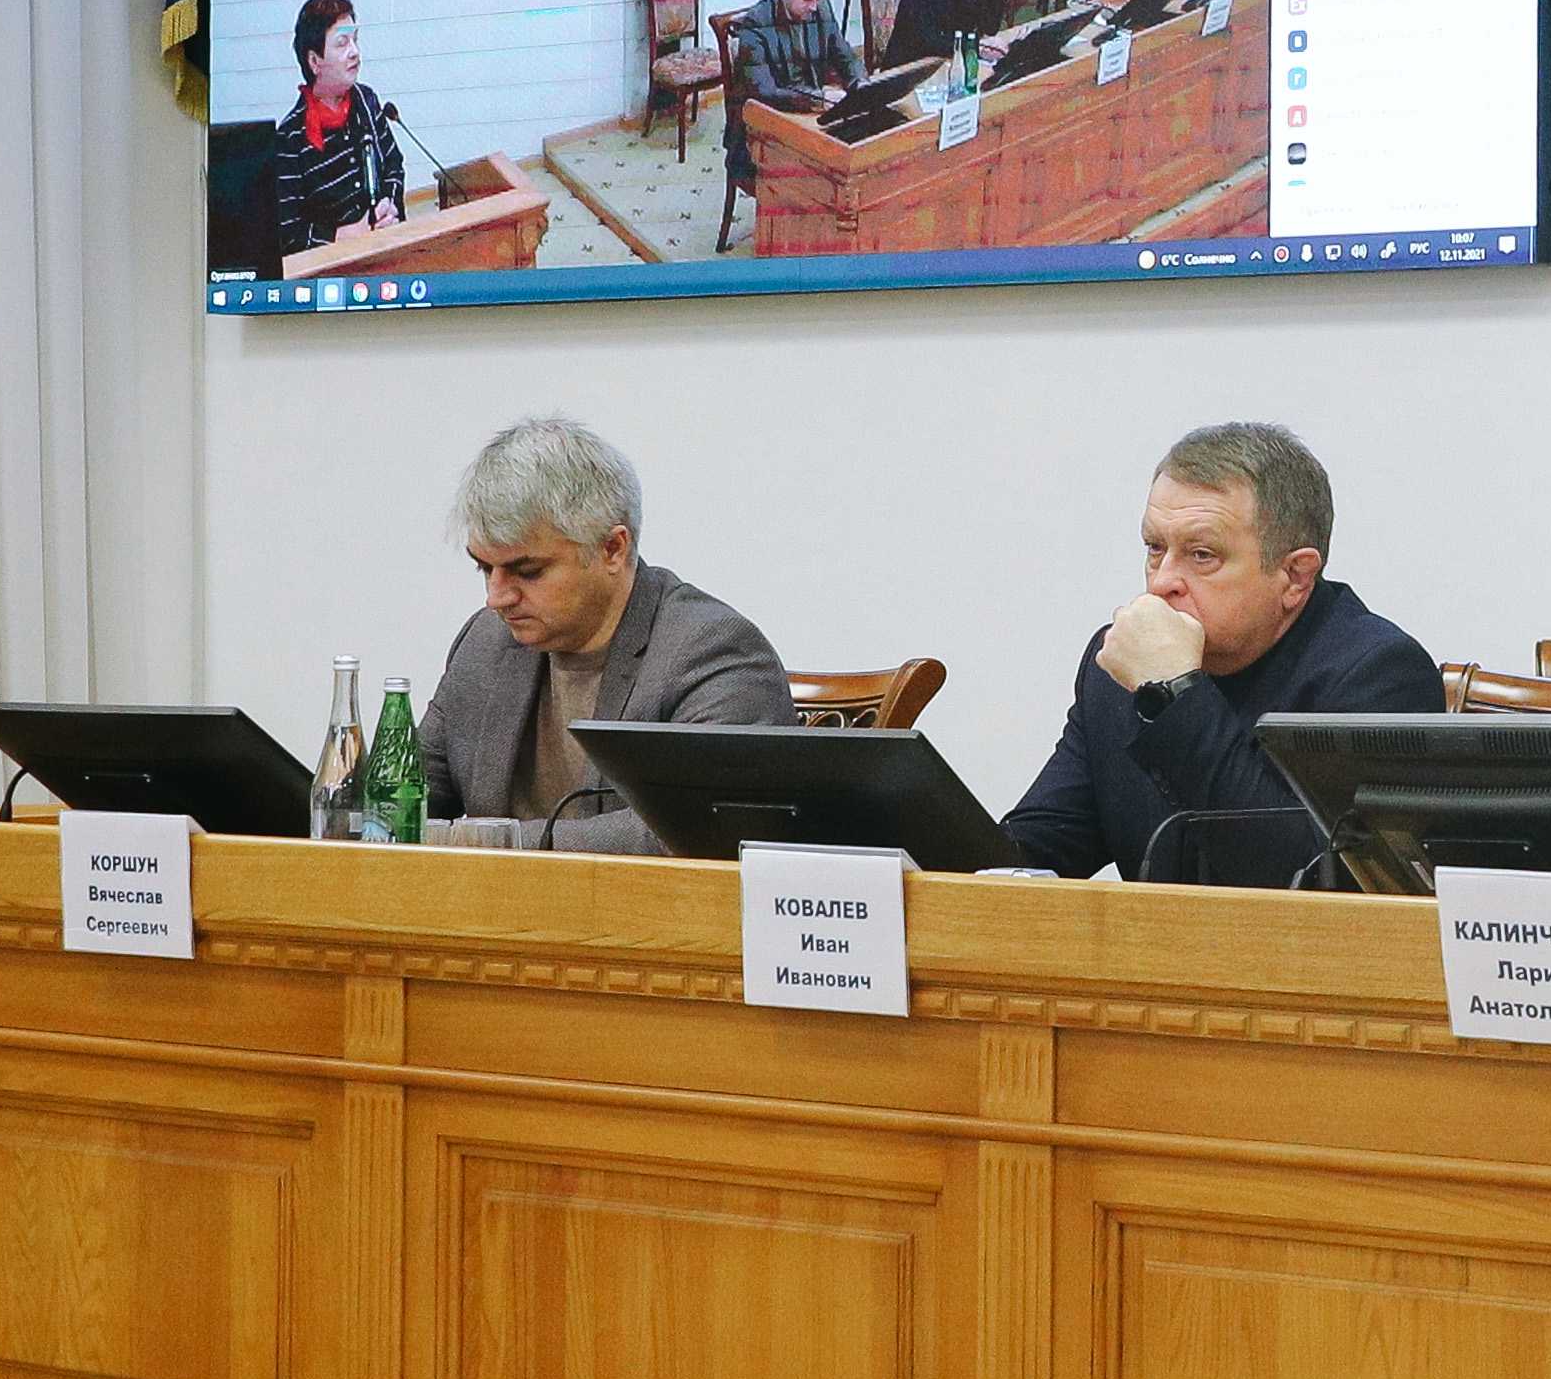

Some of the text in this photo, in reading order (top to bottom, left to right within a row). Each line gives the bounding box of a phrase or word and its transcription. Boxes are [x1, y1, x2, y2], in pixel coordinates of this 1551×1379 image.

[1451, 232, 1475, 244] 10:07
[1409, 241, 1431, 255] РУС
[1439, 248, 1486, 262] 12.11.2021
[1183, 253, 1237, 266] Солнечно
[90, 854, 159, 873] КОРШУН
[88, 885, 163, 905] Вячеслав
[774, 897, 869, 920] КОВАЛЕВ
[86, 915, 169, 936] Сергеевич
[800, 933, 850, 954] Иван
[776, 966, 872, 990] Иванович
